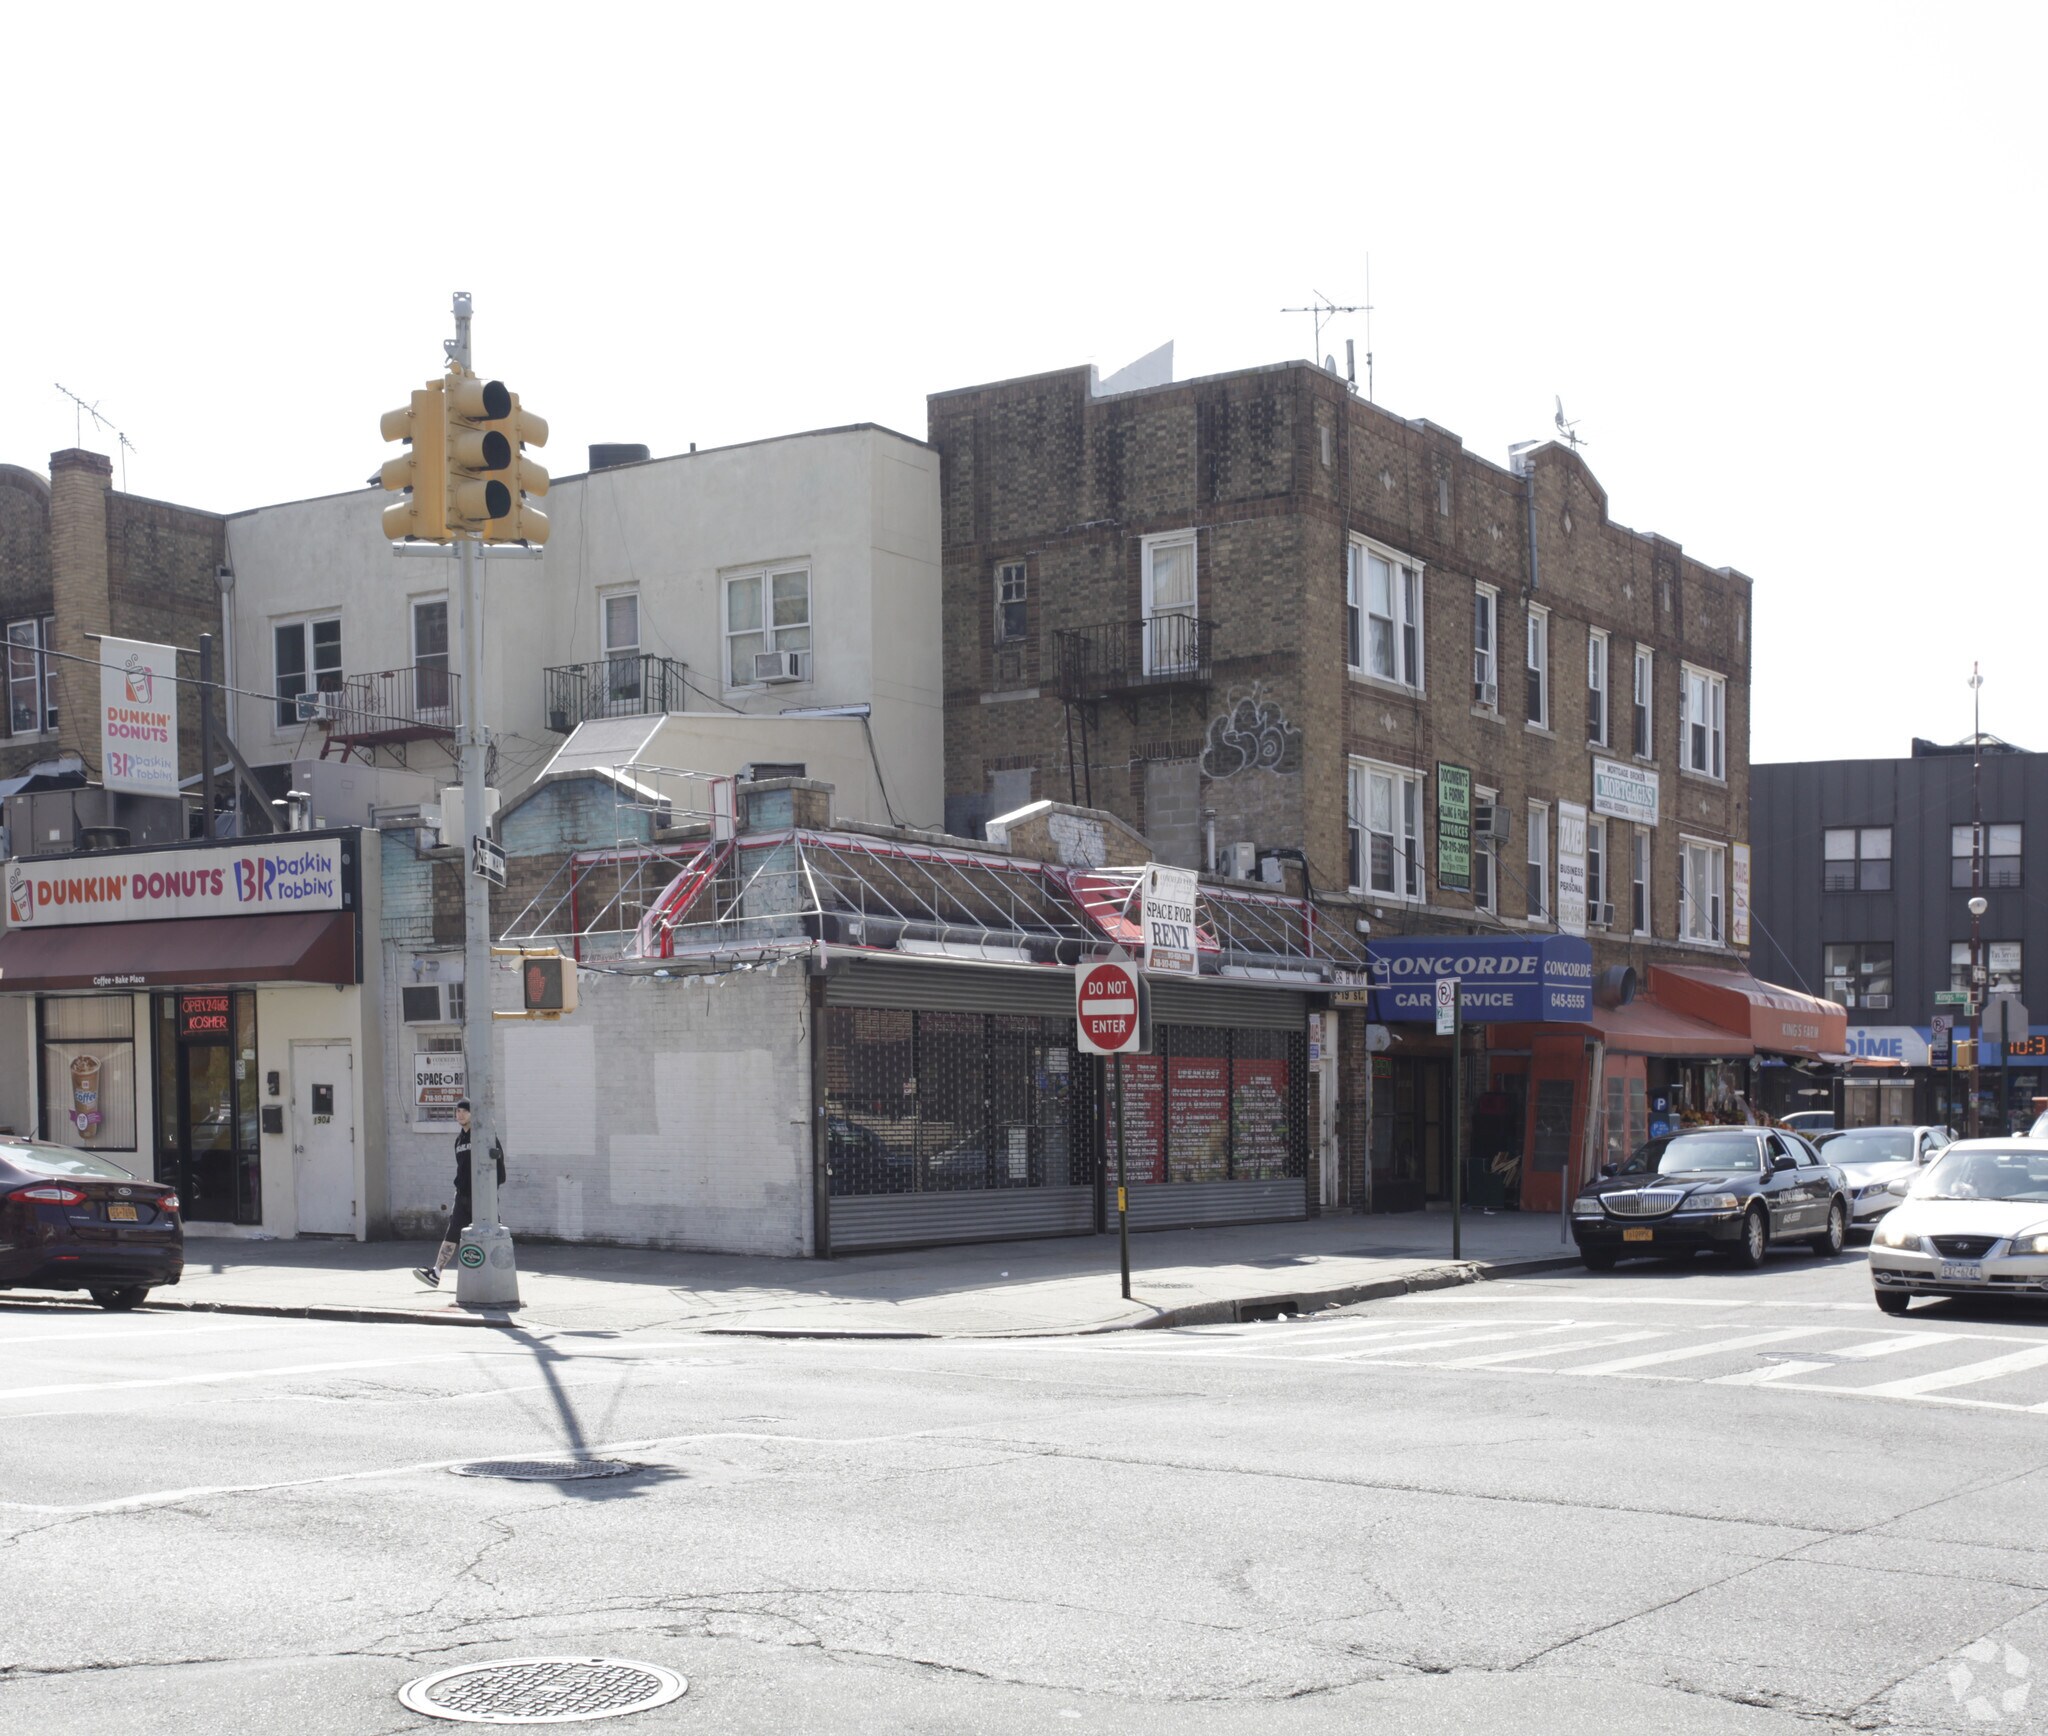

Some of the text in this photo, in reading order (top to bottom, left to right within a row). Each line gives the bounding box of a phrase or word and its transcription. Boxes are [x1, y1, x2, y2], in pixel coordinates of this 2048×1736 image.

[107, 706, 171, 727] DUNKIN'
[107, 723, 169, 743] DONUTS
[1440, 767, 1468, 788] DOCUMENTS
[1440, 824, 1469, 838] DIVORCES
[1560, 863, 1584, 877] BUSINESS
[37, 875, 127, 906] DUNKIN'
[132, 869, 225, 900] DONUTS
[278, 876, 334, 900] robbins
[1560, 881, 1584, 894] PERSONAL
[1146, 901, 1192, 923] SPACE FOR
[1151, 922, 1190, 950] RENT
[1372, 956, 1538, 975] CONCORDE
[1544, 960, 1591, 978] CONCORDE
[93, 974, 145, 987] Coffee Bake Place
[1088, 981, 1127, 996] DO NOT
[1395, 993, 1514, 1007] CAR RVICE
[1551, 993, 1585, 1009] 645-5555
[1936, 994, 1954, 1003] Kings
[182, 1000, 206, 1013] OPEN
[189, 1015, 227, 1029] KOSHER
[1092, 1020, 1126, 1035] ENTER
[1782, 1023, 1819, 1038] KING'S FARM
[417, 1072, 443, 1086] SPACE
[313, 1115, 331, 1126] 1904
